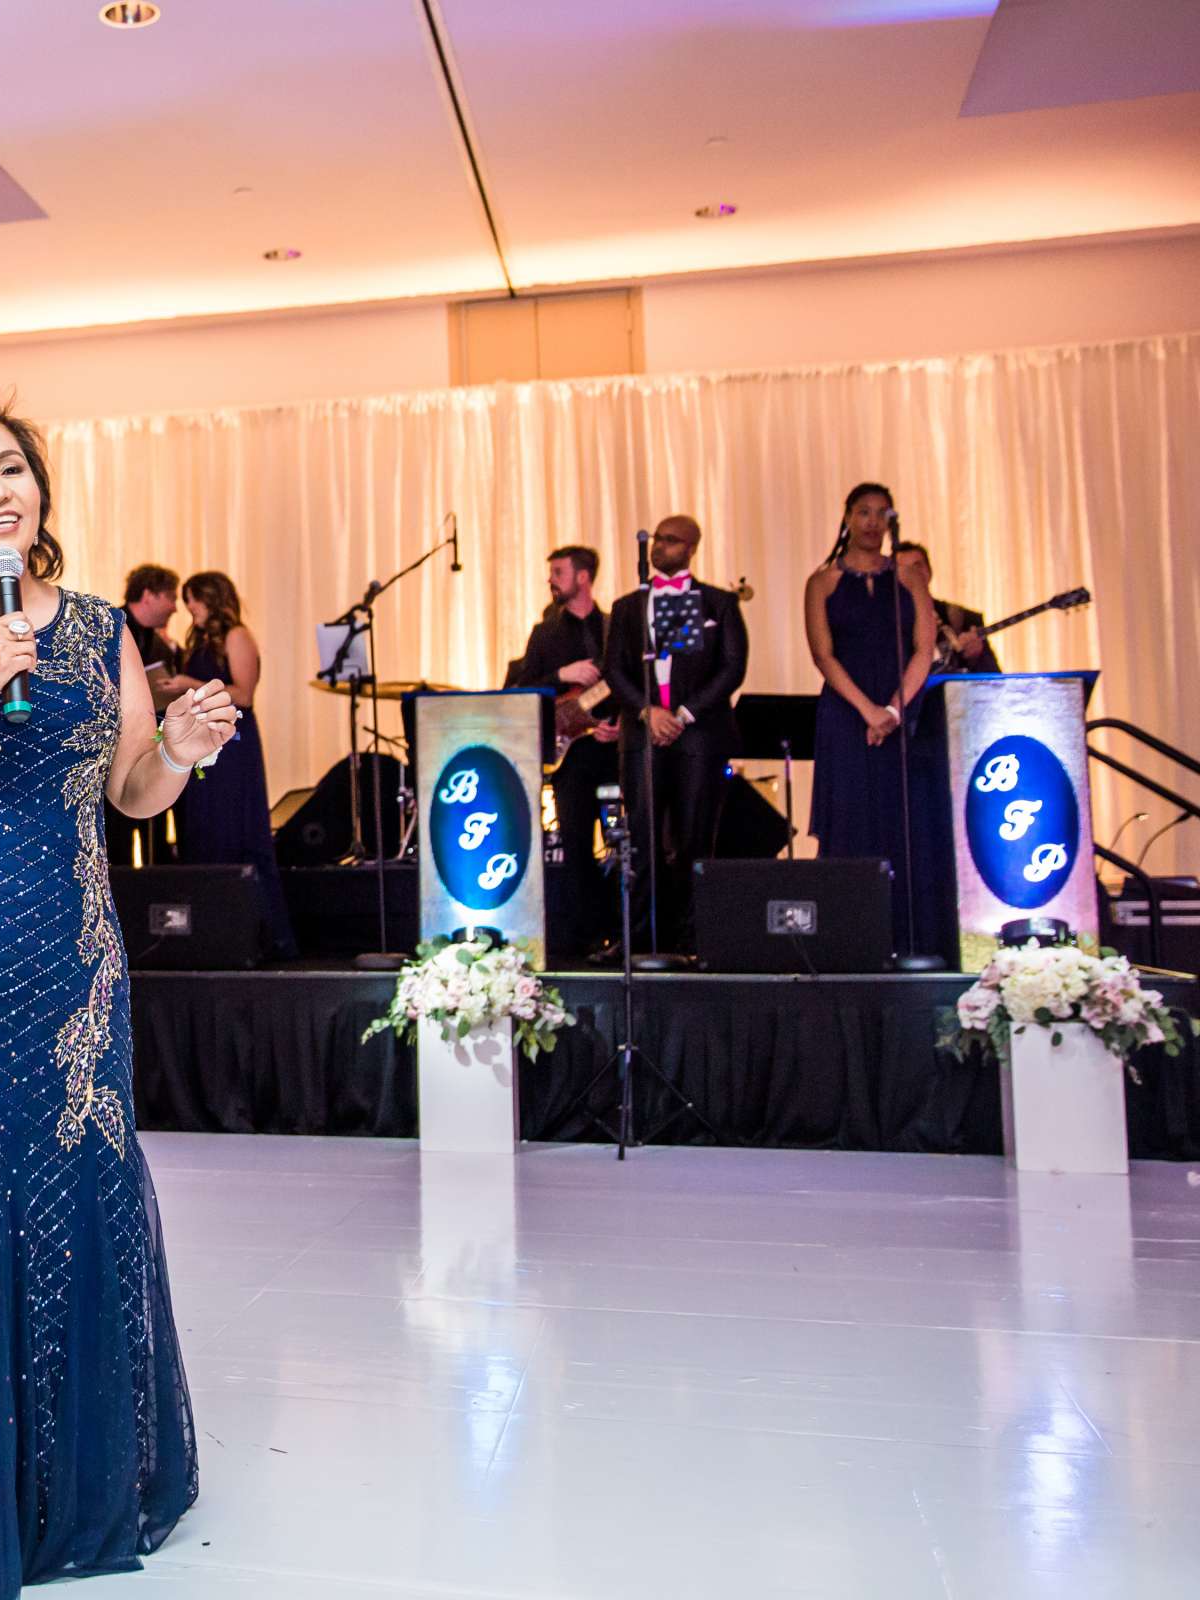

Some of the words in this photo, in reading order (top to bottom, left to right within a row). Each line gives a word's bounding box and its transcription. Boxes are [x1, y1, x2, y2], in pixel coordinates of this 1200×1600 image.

[439, 768, 480, 804] B
[975, 754, 1020, 792] B
[459, 812, 498, 850] F
[999, 799, 1043, 841] F
[478, 853, 518, 889] P
[1023, 843, 1068, 882] P
